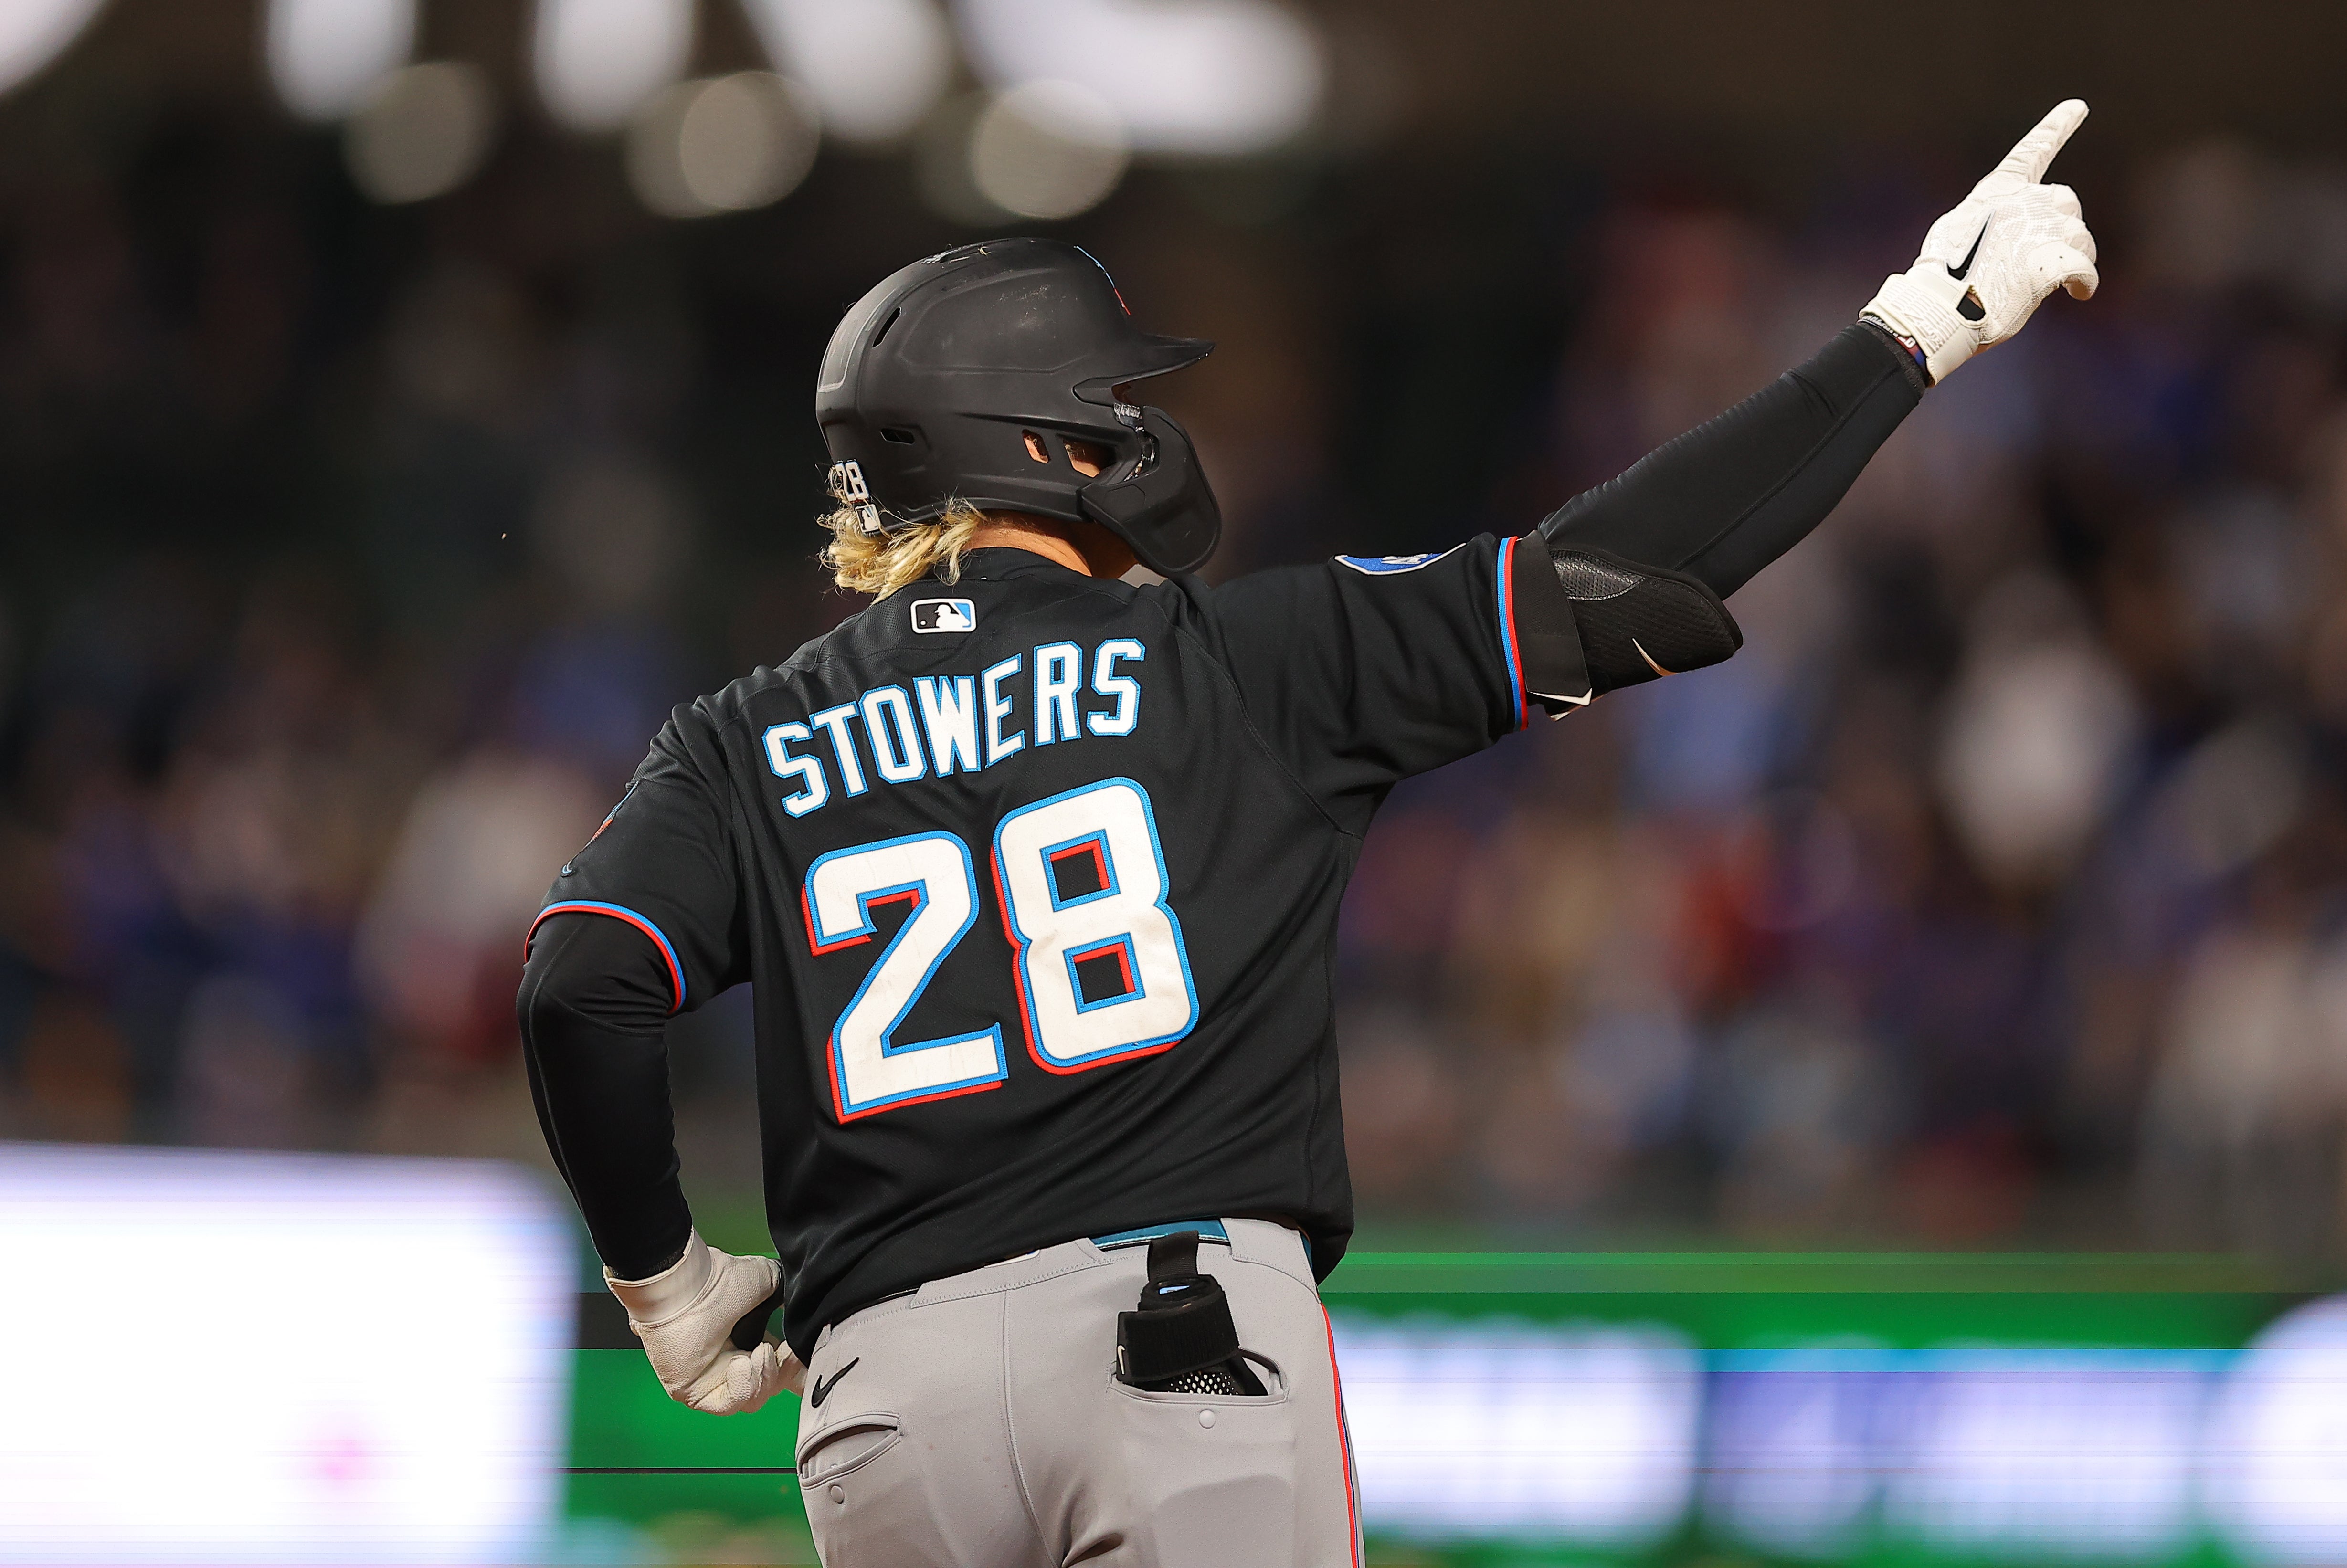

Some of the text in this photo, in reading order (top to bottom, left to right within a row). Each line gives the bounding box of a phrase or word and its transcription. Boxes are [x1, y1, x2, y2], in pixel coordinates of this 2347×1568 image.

[835, 461, 869, 503] 28
[762, 638, 1146, 818] STOWERS
[801, 776, 1200, 1124] 28
